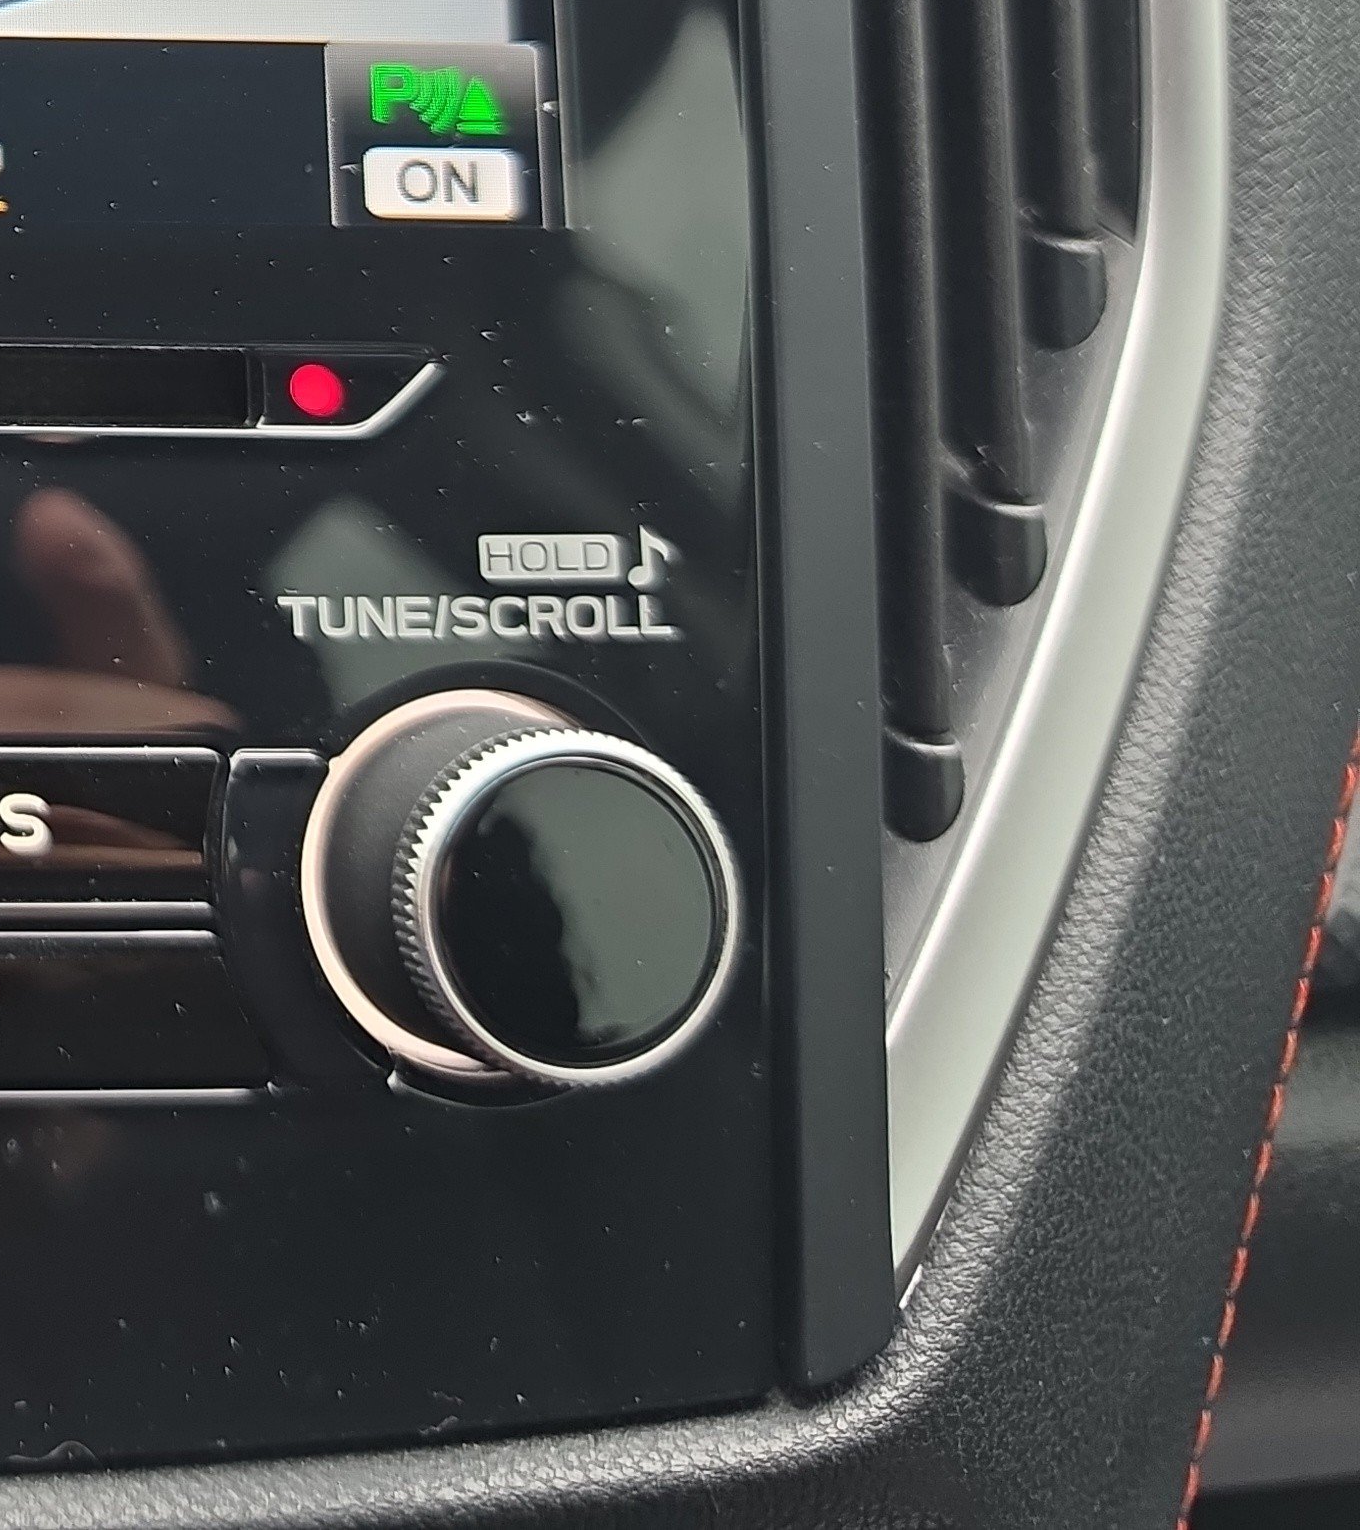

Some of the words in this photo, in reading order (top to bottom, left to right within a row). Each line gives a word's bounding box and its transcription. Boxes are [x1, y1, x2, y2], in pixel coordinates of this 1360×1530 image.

[396, 159, 480, 204] ON
[484, 540, 612, 574] HOLD
[278, 593, 678, 640] TUNE/SCROLL
